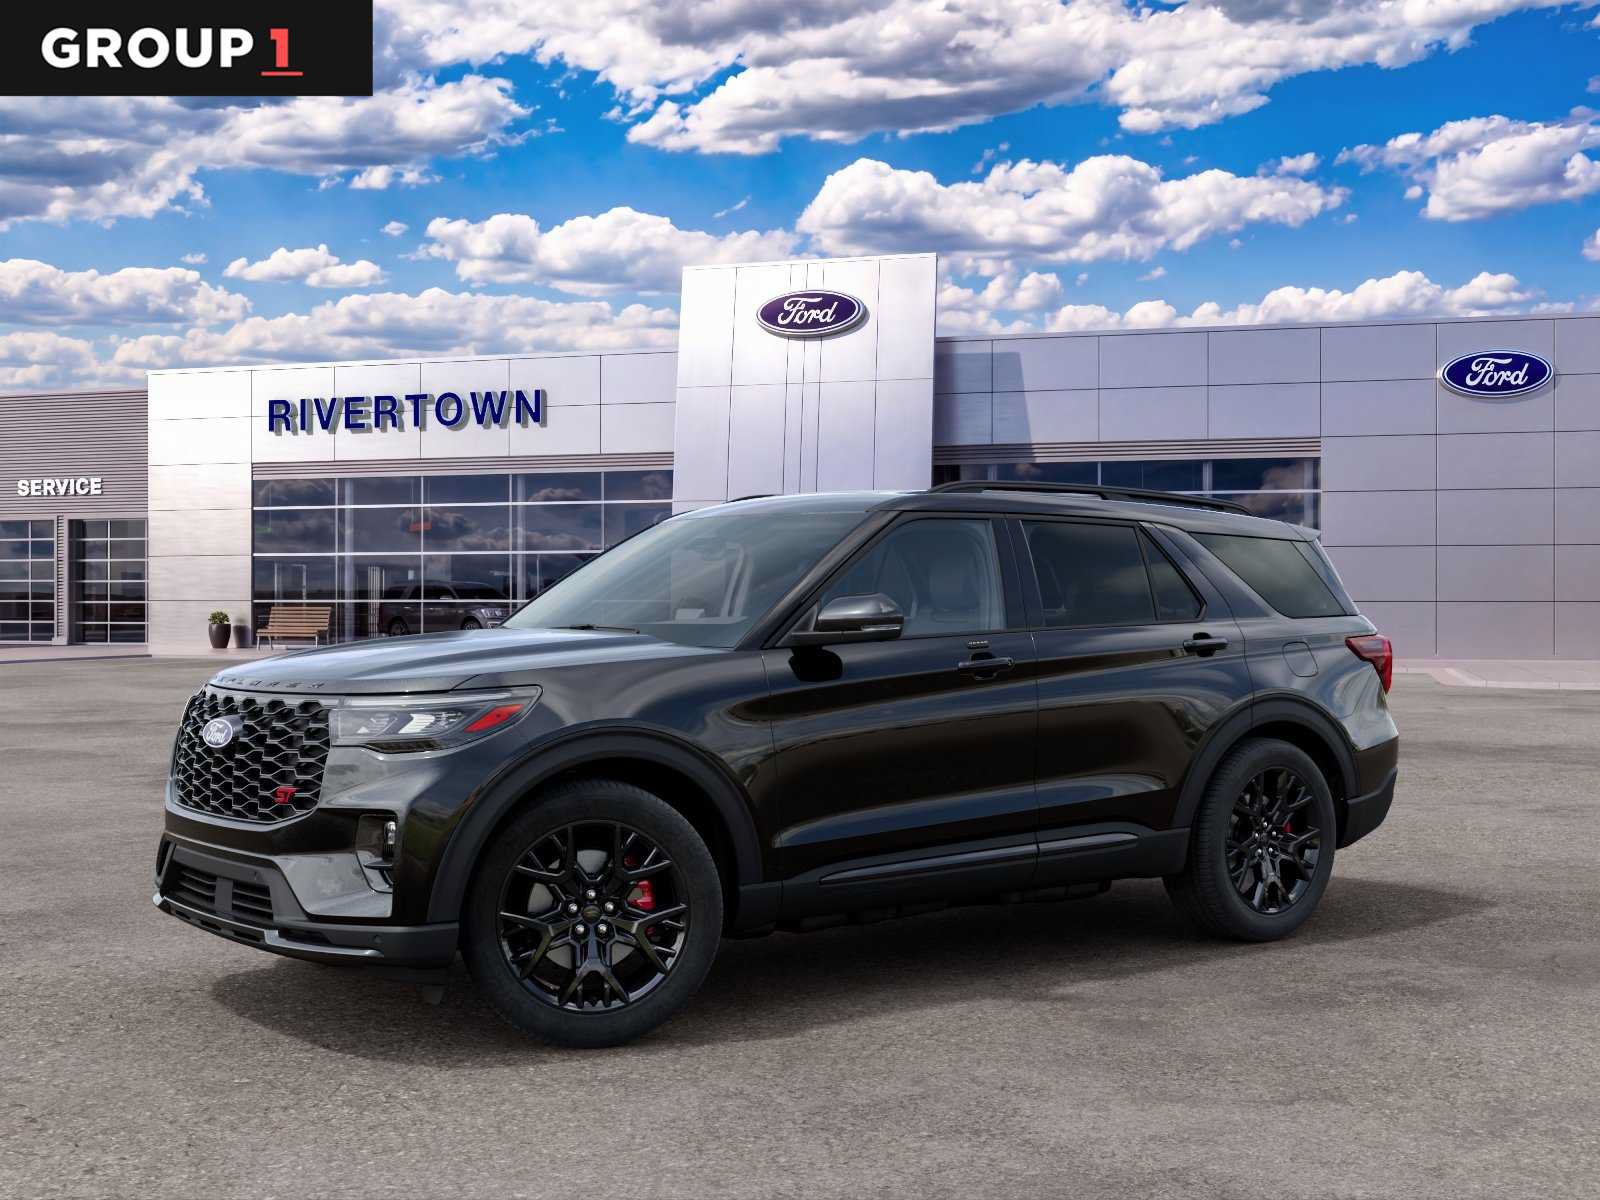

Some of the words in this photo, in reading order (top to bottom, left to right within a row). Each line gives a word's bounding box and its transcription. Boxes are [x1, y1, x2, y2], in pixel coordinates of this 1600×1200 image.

[777, 297, 838, 325] Ford
[1465, 357, 1529, 386] Ford
[268, 389, 543, 433] RIVERTOWN
[17, 477, 103, 496] SERVICE
[205, 721, 228, 743] Ford
